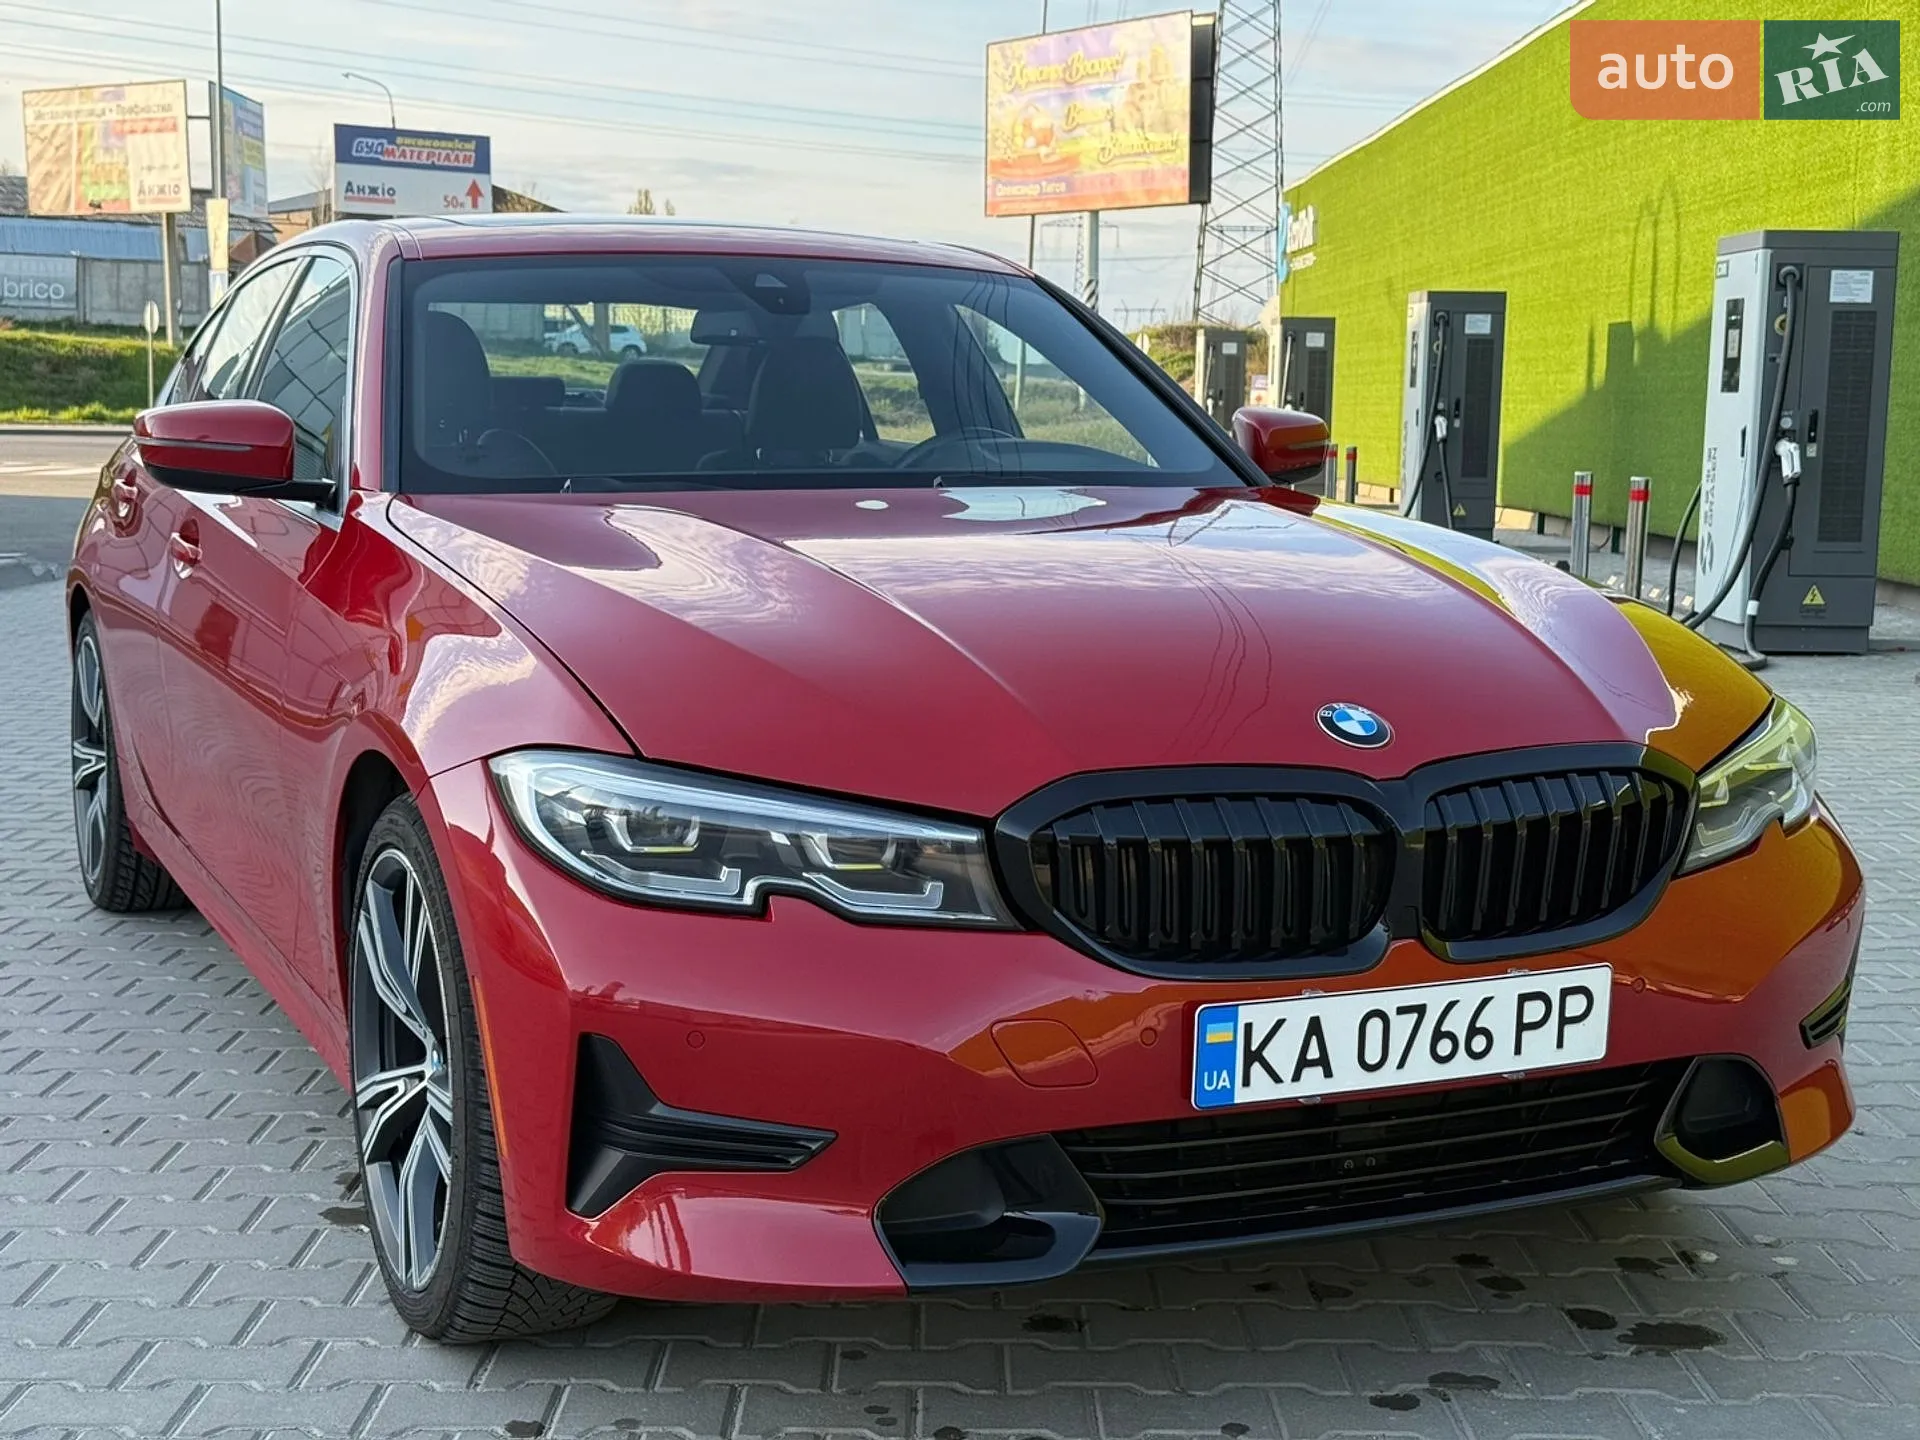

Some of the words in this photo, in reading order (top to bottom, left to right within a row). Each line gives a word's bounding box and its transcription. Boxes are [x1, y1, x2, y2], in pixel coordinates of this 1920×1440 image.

[344, 180, 396, 197] Анжіо
[3, 276, 65, 300] brico
[1241, 1015, 1334, 1088] KA
[1356, 995, 1495, 1073] 0766
[1513, 984, 1595, 1056] PP
[1203, 1069, 1231, 1091] UA
